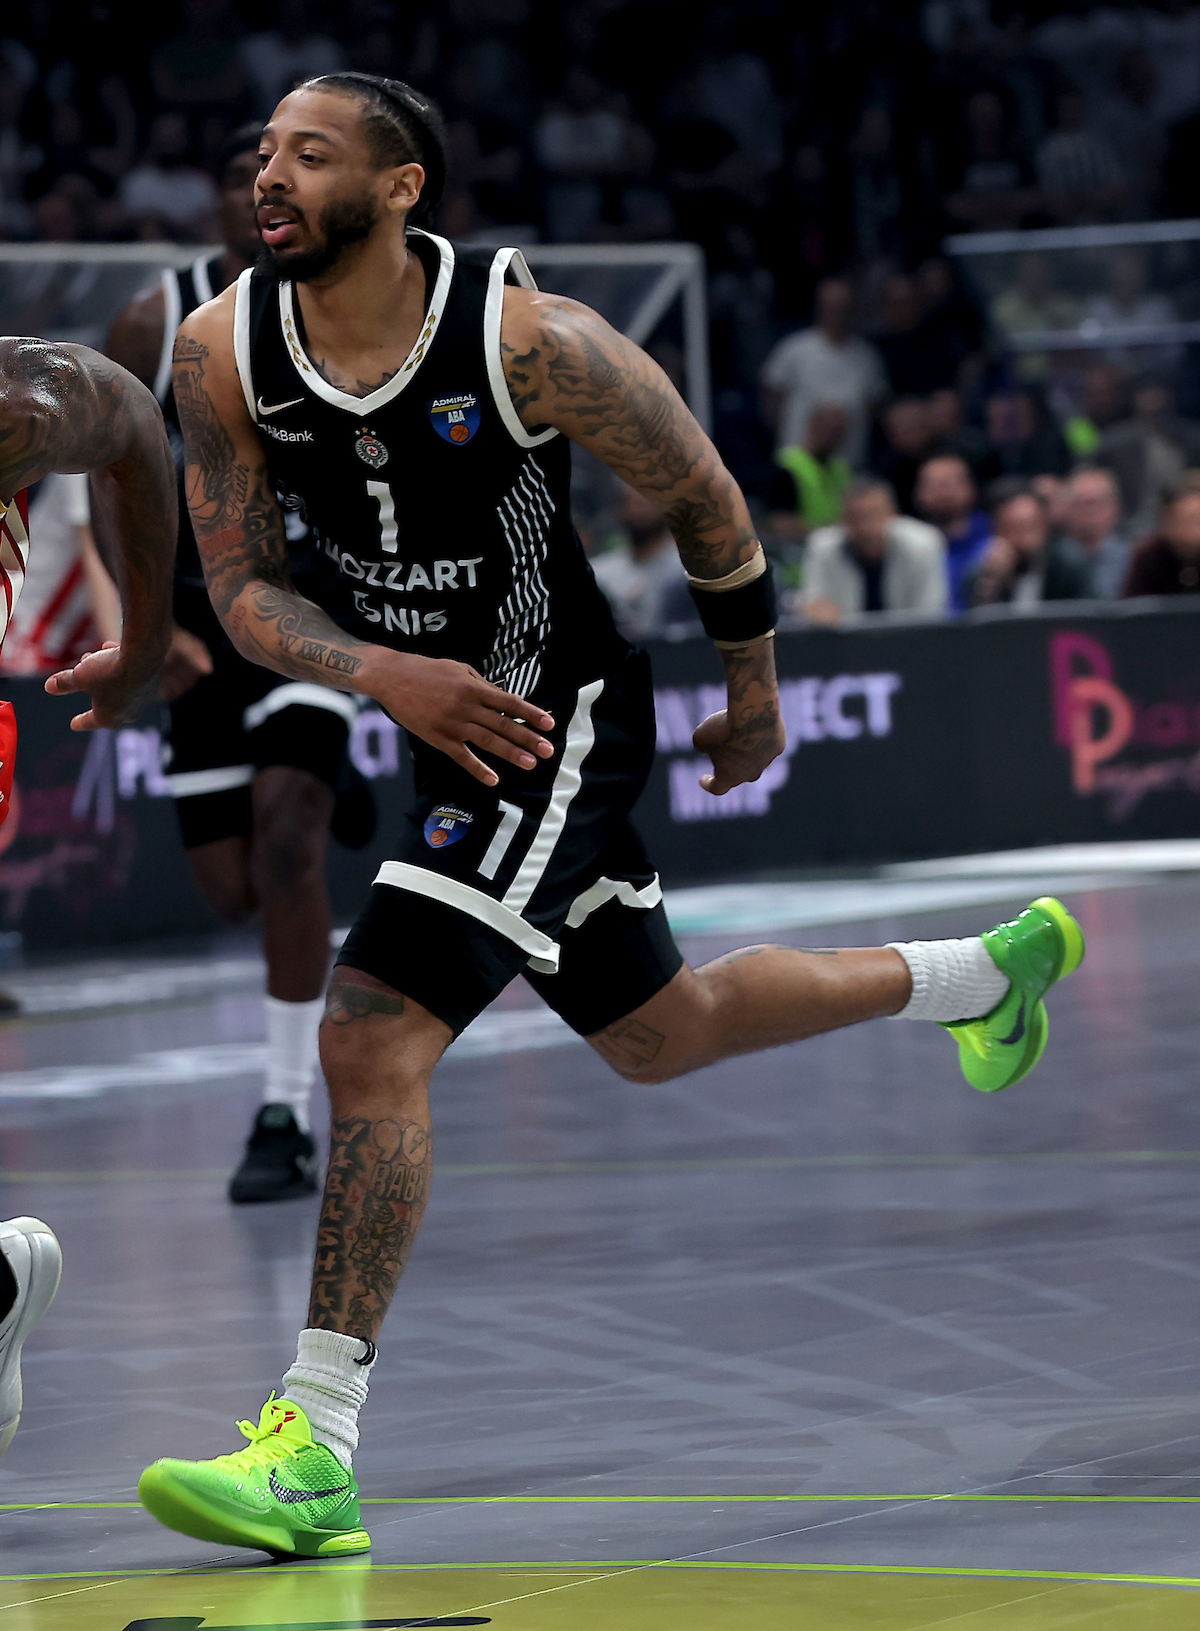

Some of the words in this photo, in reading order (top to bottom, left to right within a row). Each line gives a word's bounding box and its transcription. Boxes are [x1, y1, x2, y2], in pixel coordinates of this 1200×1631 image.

[432, 393, 476, 407] ADMIRAL
[447, 409, 466, 424] ABA
[366, 479, 399, 553] 1
[437, 806, 474, 820] ADMIRAL
[438, 818, 456, 831] ABA
[476, 799, 524, 881] 1
